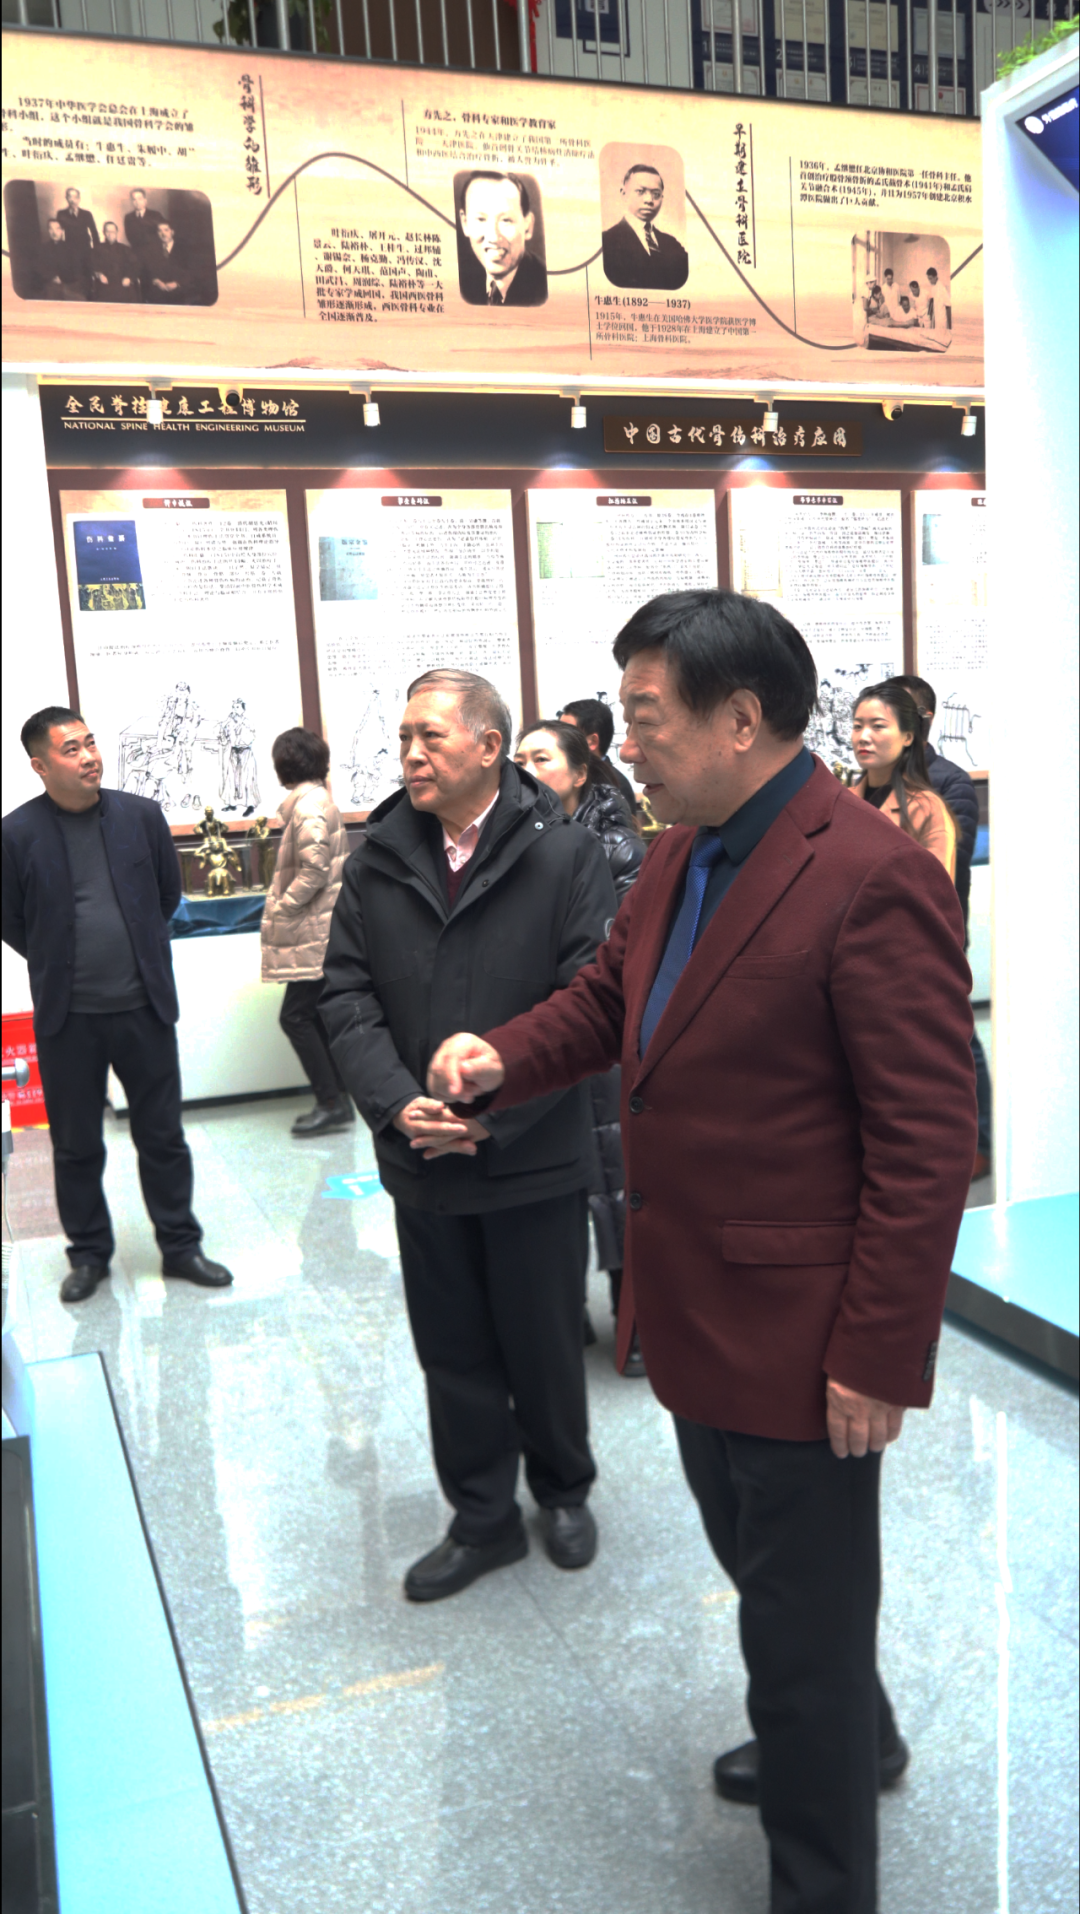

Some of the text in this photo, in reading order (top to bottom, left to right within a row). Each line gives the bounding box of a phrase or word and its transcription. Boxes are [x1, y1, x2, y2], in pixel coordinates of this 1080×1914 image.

[64, 421, 305, 432] NATIONAL SPINE HEALTH ENGINEERING MUSEUM
[623, 422, 847, 448] 中国古代骨伤科治疗应用
[2, 1043, 37, 1058] 火器箱
